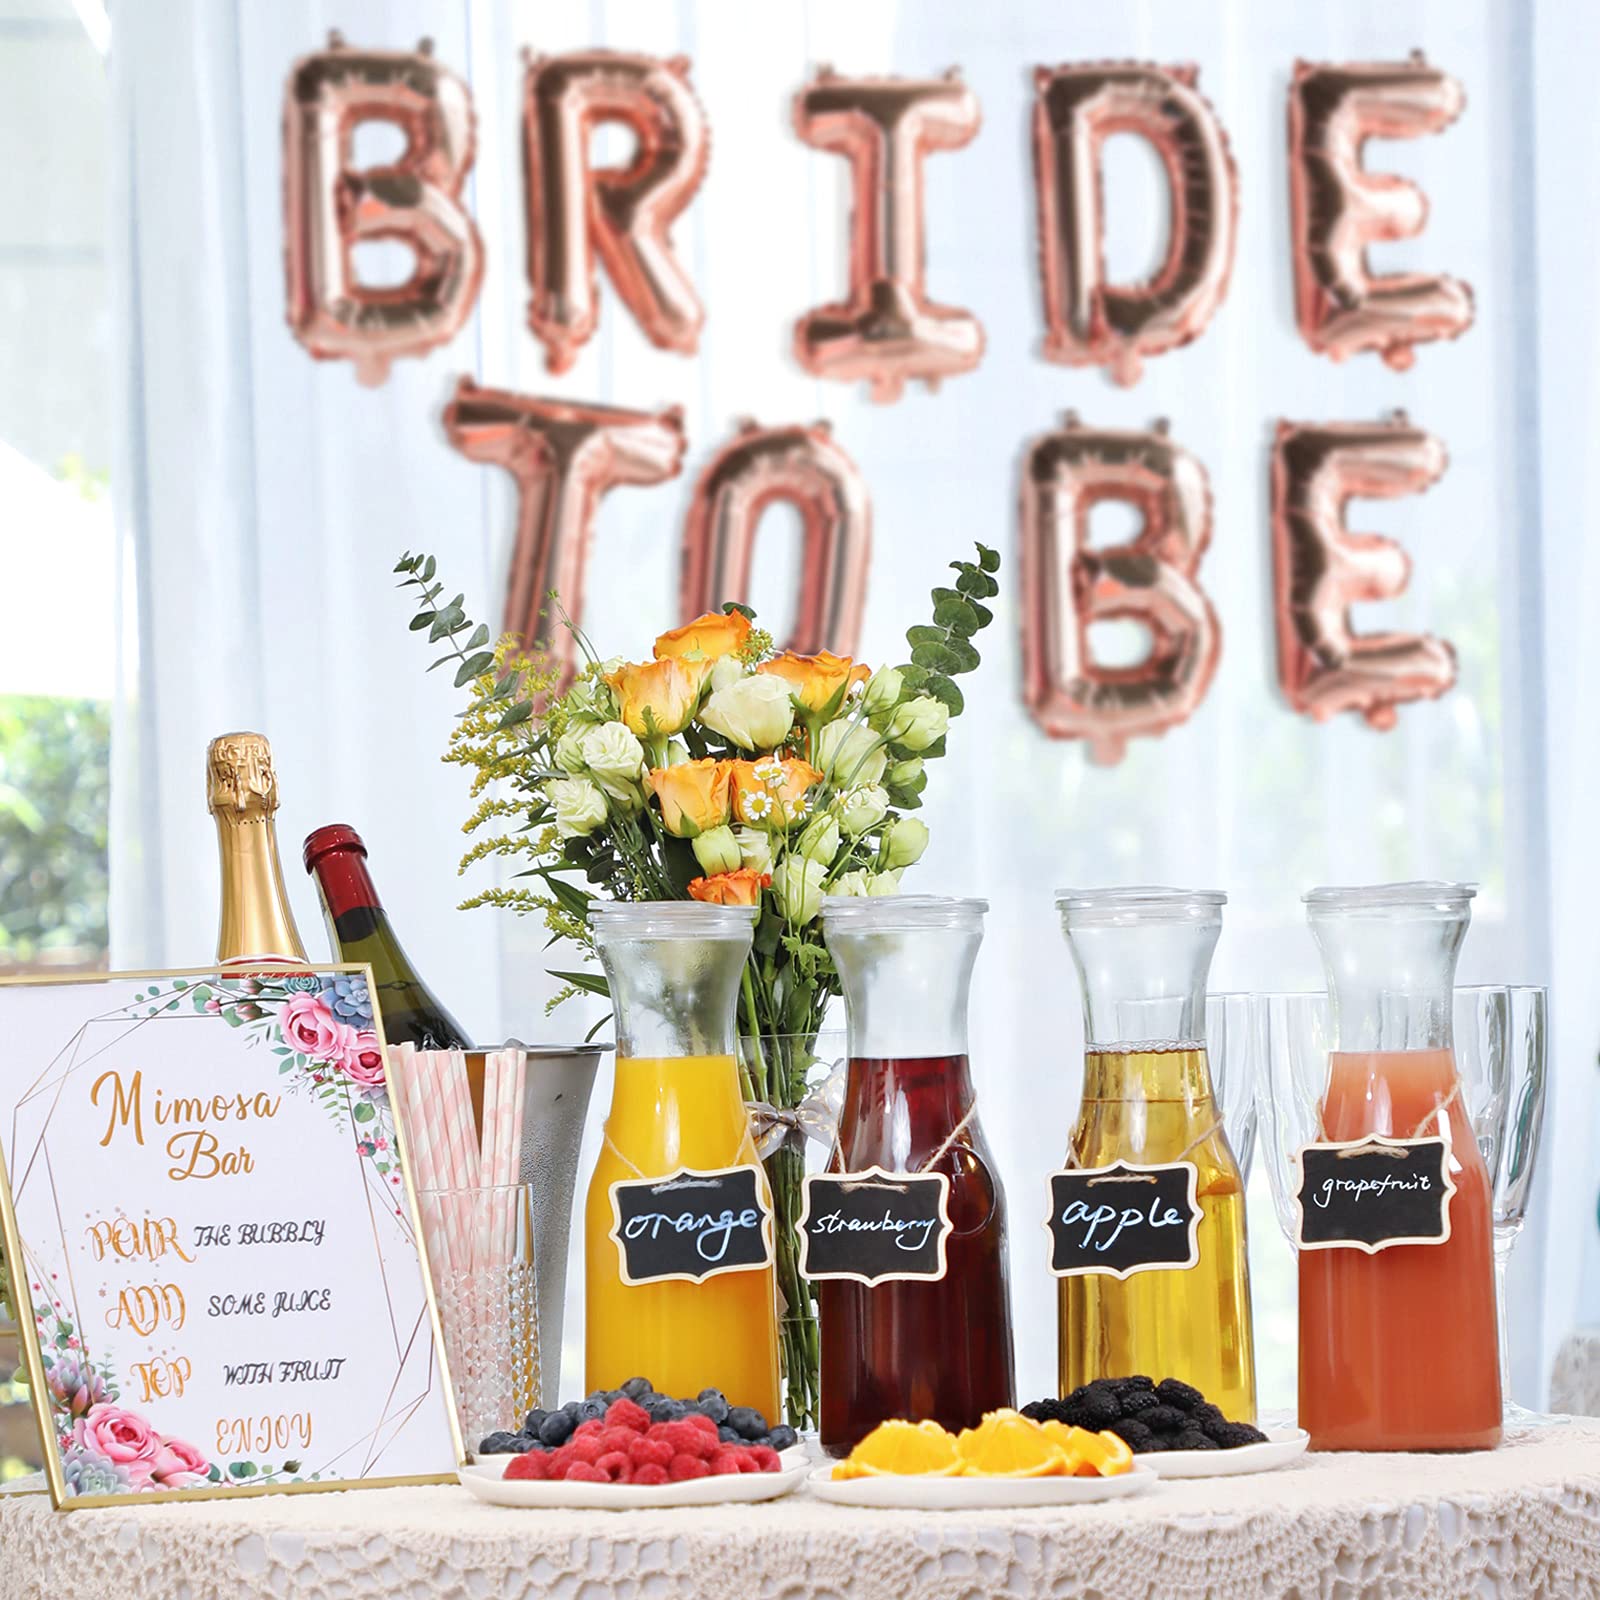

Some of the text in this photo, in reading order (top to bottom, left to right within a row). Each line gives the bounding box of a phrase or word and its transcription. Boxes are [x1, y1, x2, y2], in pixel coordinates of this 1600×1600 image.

[282, 32, 1475, 402] BRIDE
[442, 375, 1459, 766] TO BE
[90, 1070, 282, 1147] Mimosa
[166, 1129, 256, 1181] Bar
[1312, 1173, 1431, 1208] grapefruit
[85, 1216, 326, 1263] POUR THE BUBBLY
[624, 1207, 759, 1261] orange
[1061, 1196, 1184, 1250] apple
[105, 1283, 332, 1337] ADD SOME JUICE
[129, 1356, 347, 1404] TOP WITH FRUIT
[215, 1411, 313, 1456] ENJOY
